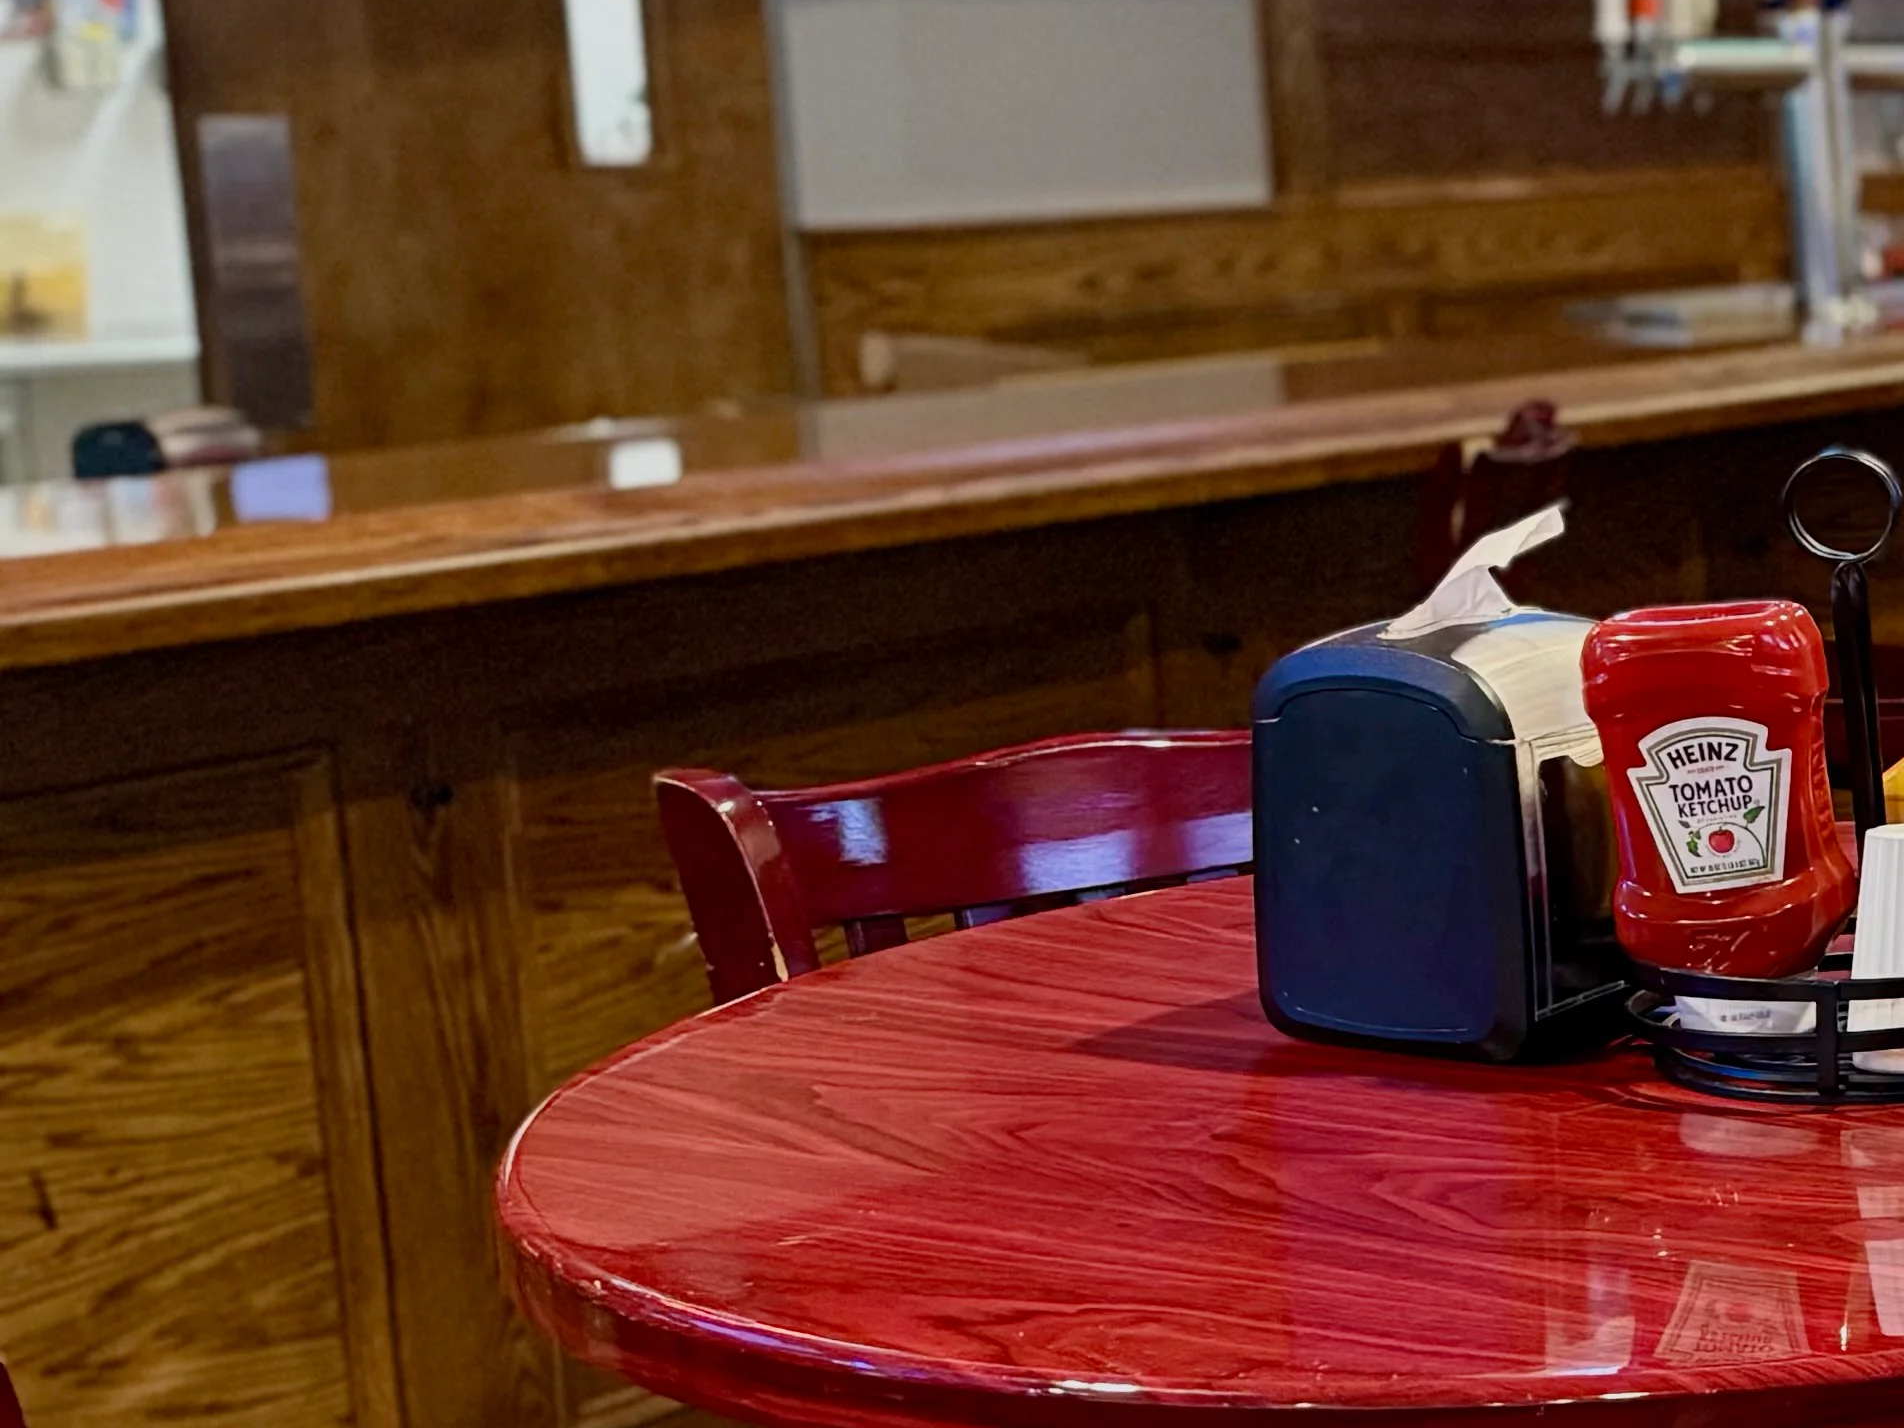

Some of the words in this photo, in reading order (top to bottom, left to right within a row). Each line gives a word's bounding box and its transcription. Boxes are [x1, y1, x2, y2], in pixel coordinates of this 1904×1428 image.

[1667, 741, 1739, 770] HEINZ
[1669, 774, 1753, 803] TOMATO
[1677, 794, 1753, 819] KETCHUP
